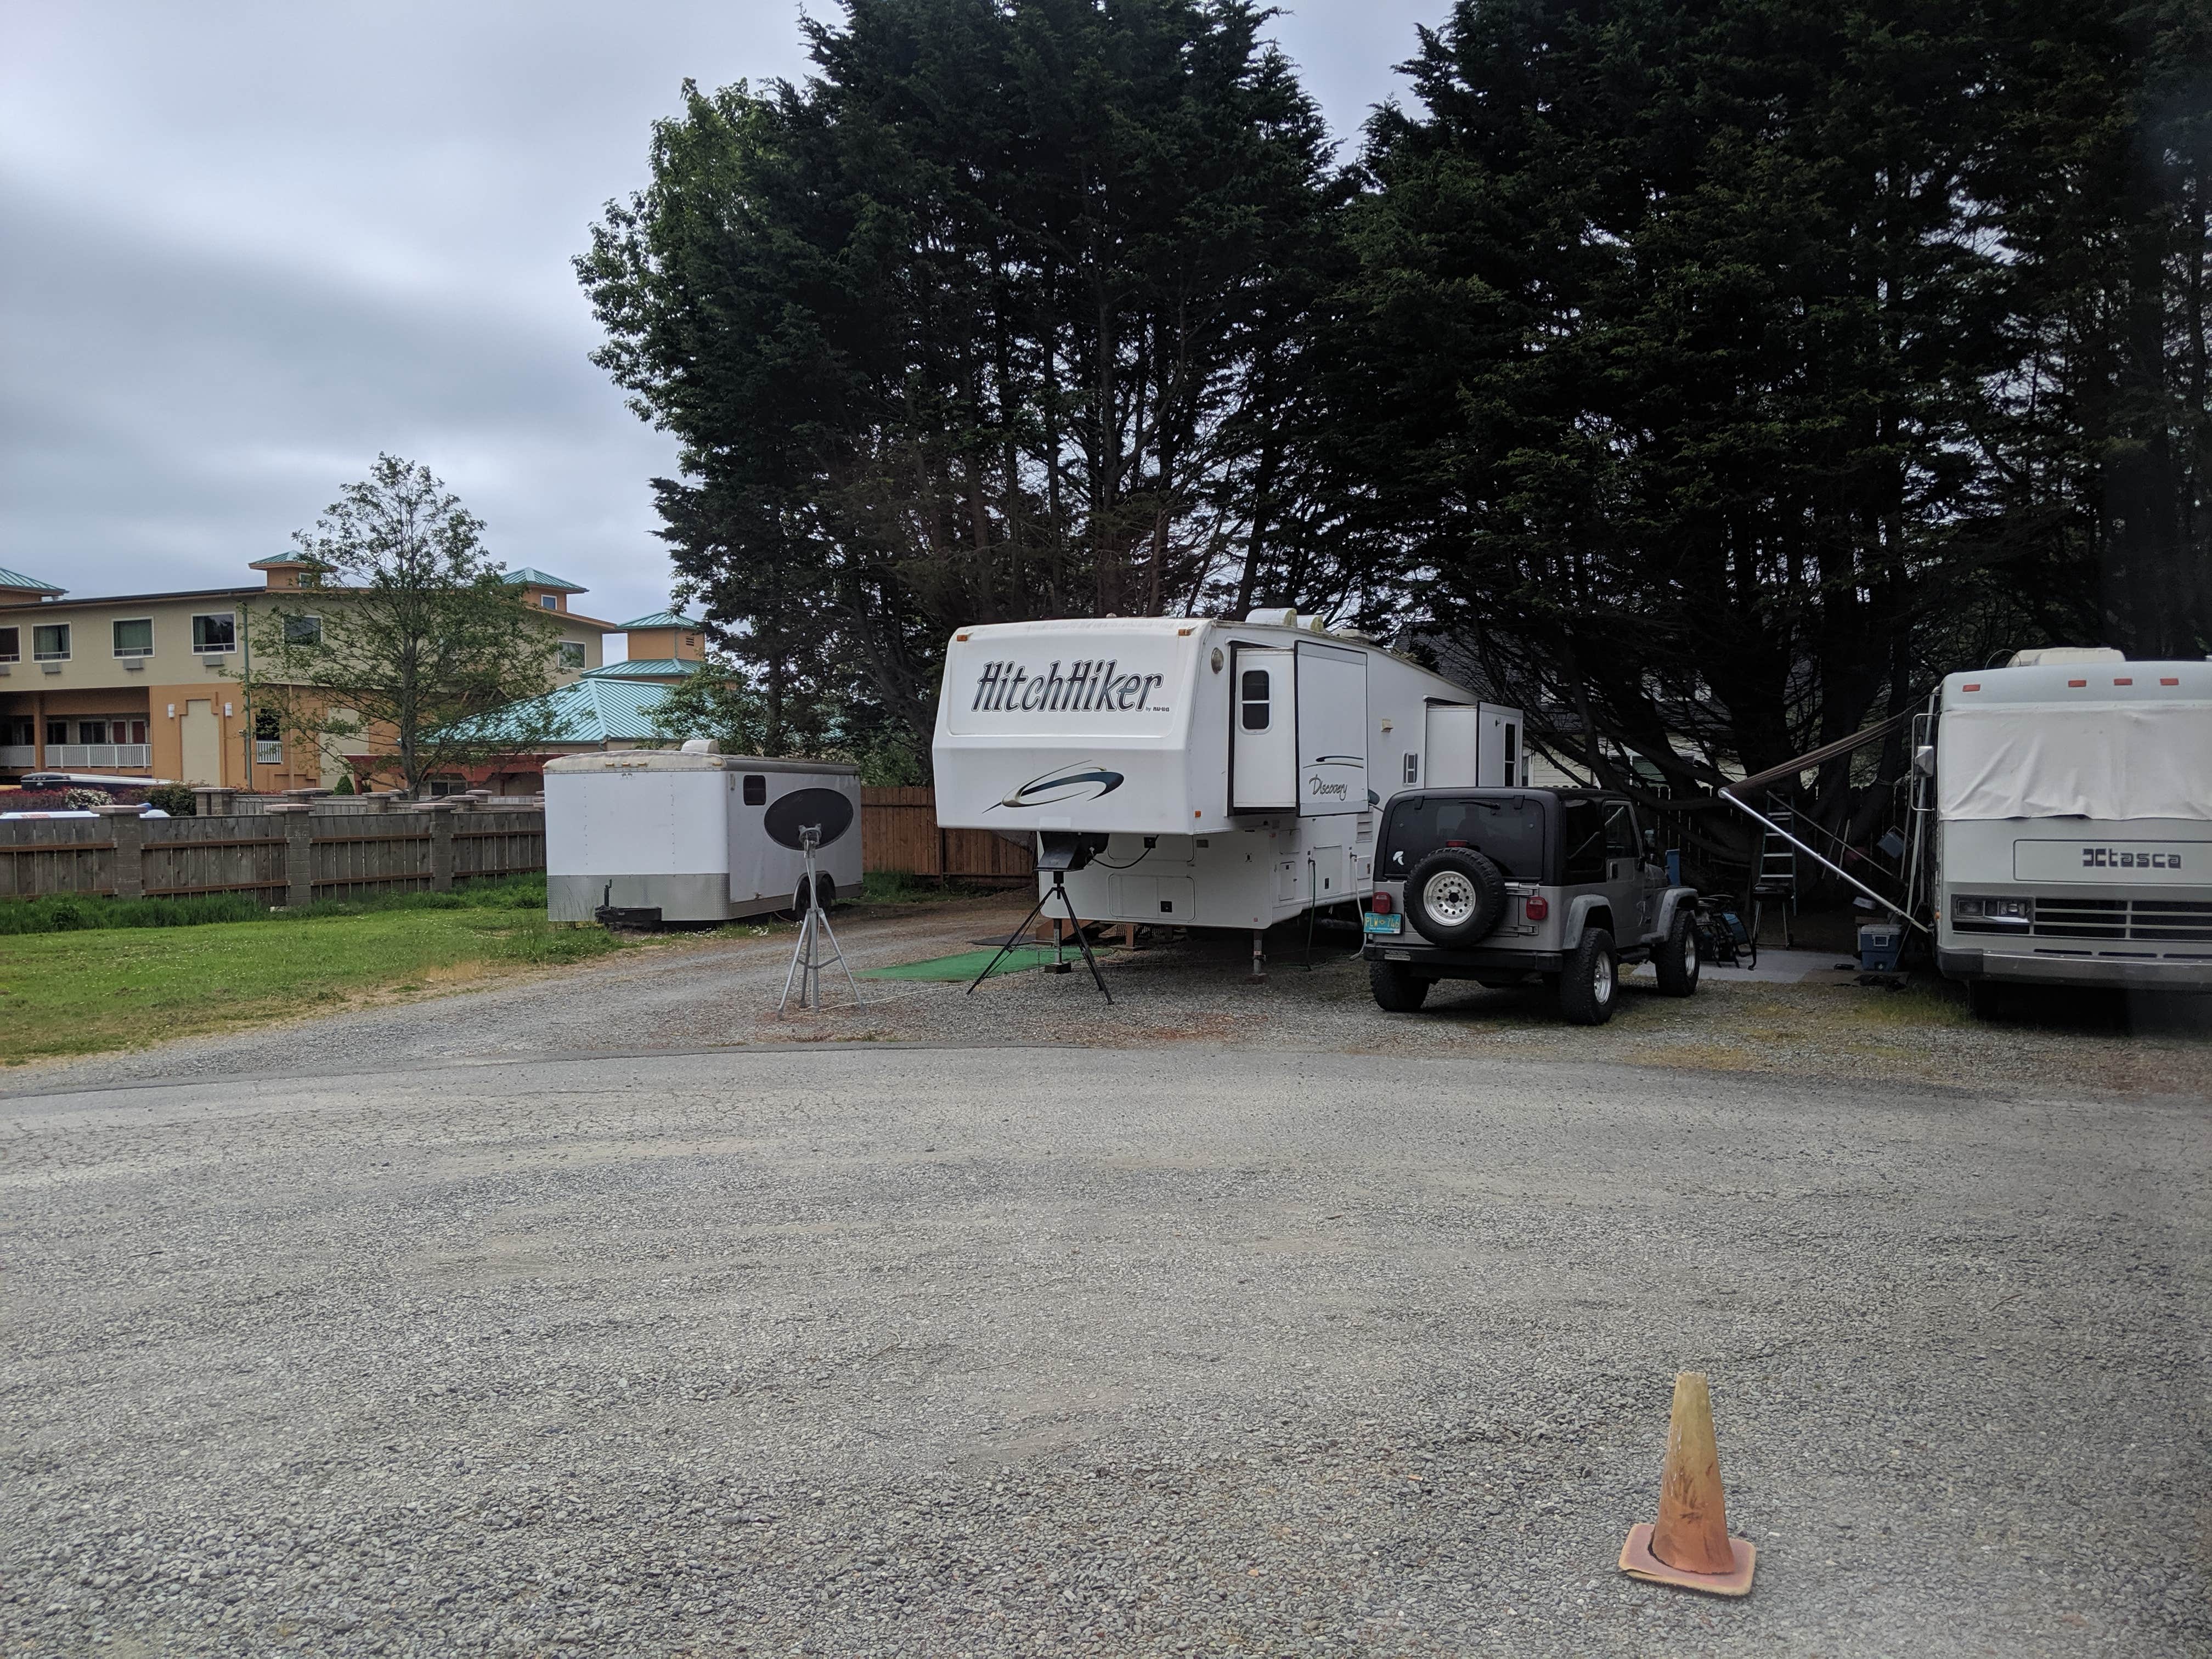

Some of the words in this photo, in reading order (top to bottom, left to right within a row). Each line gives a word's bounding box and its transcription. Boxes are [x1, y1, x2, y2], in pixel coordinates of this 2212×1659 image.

[971, 659, 1164, 712] HitchHiker
[1309, 774, 1347, 801] Discovery
[2083, 848, 2181, 868] Itasca
